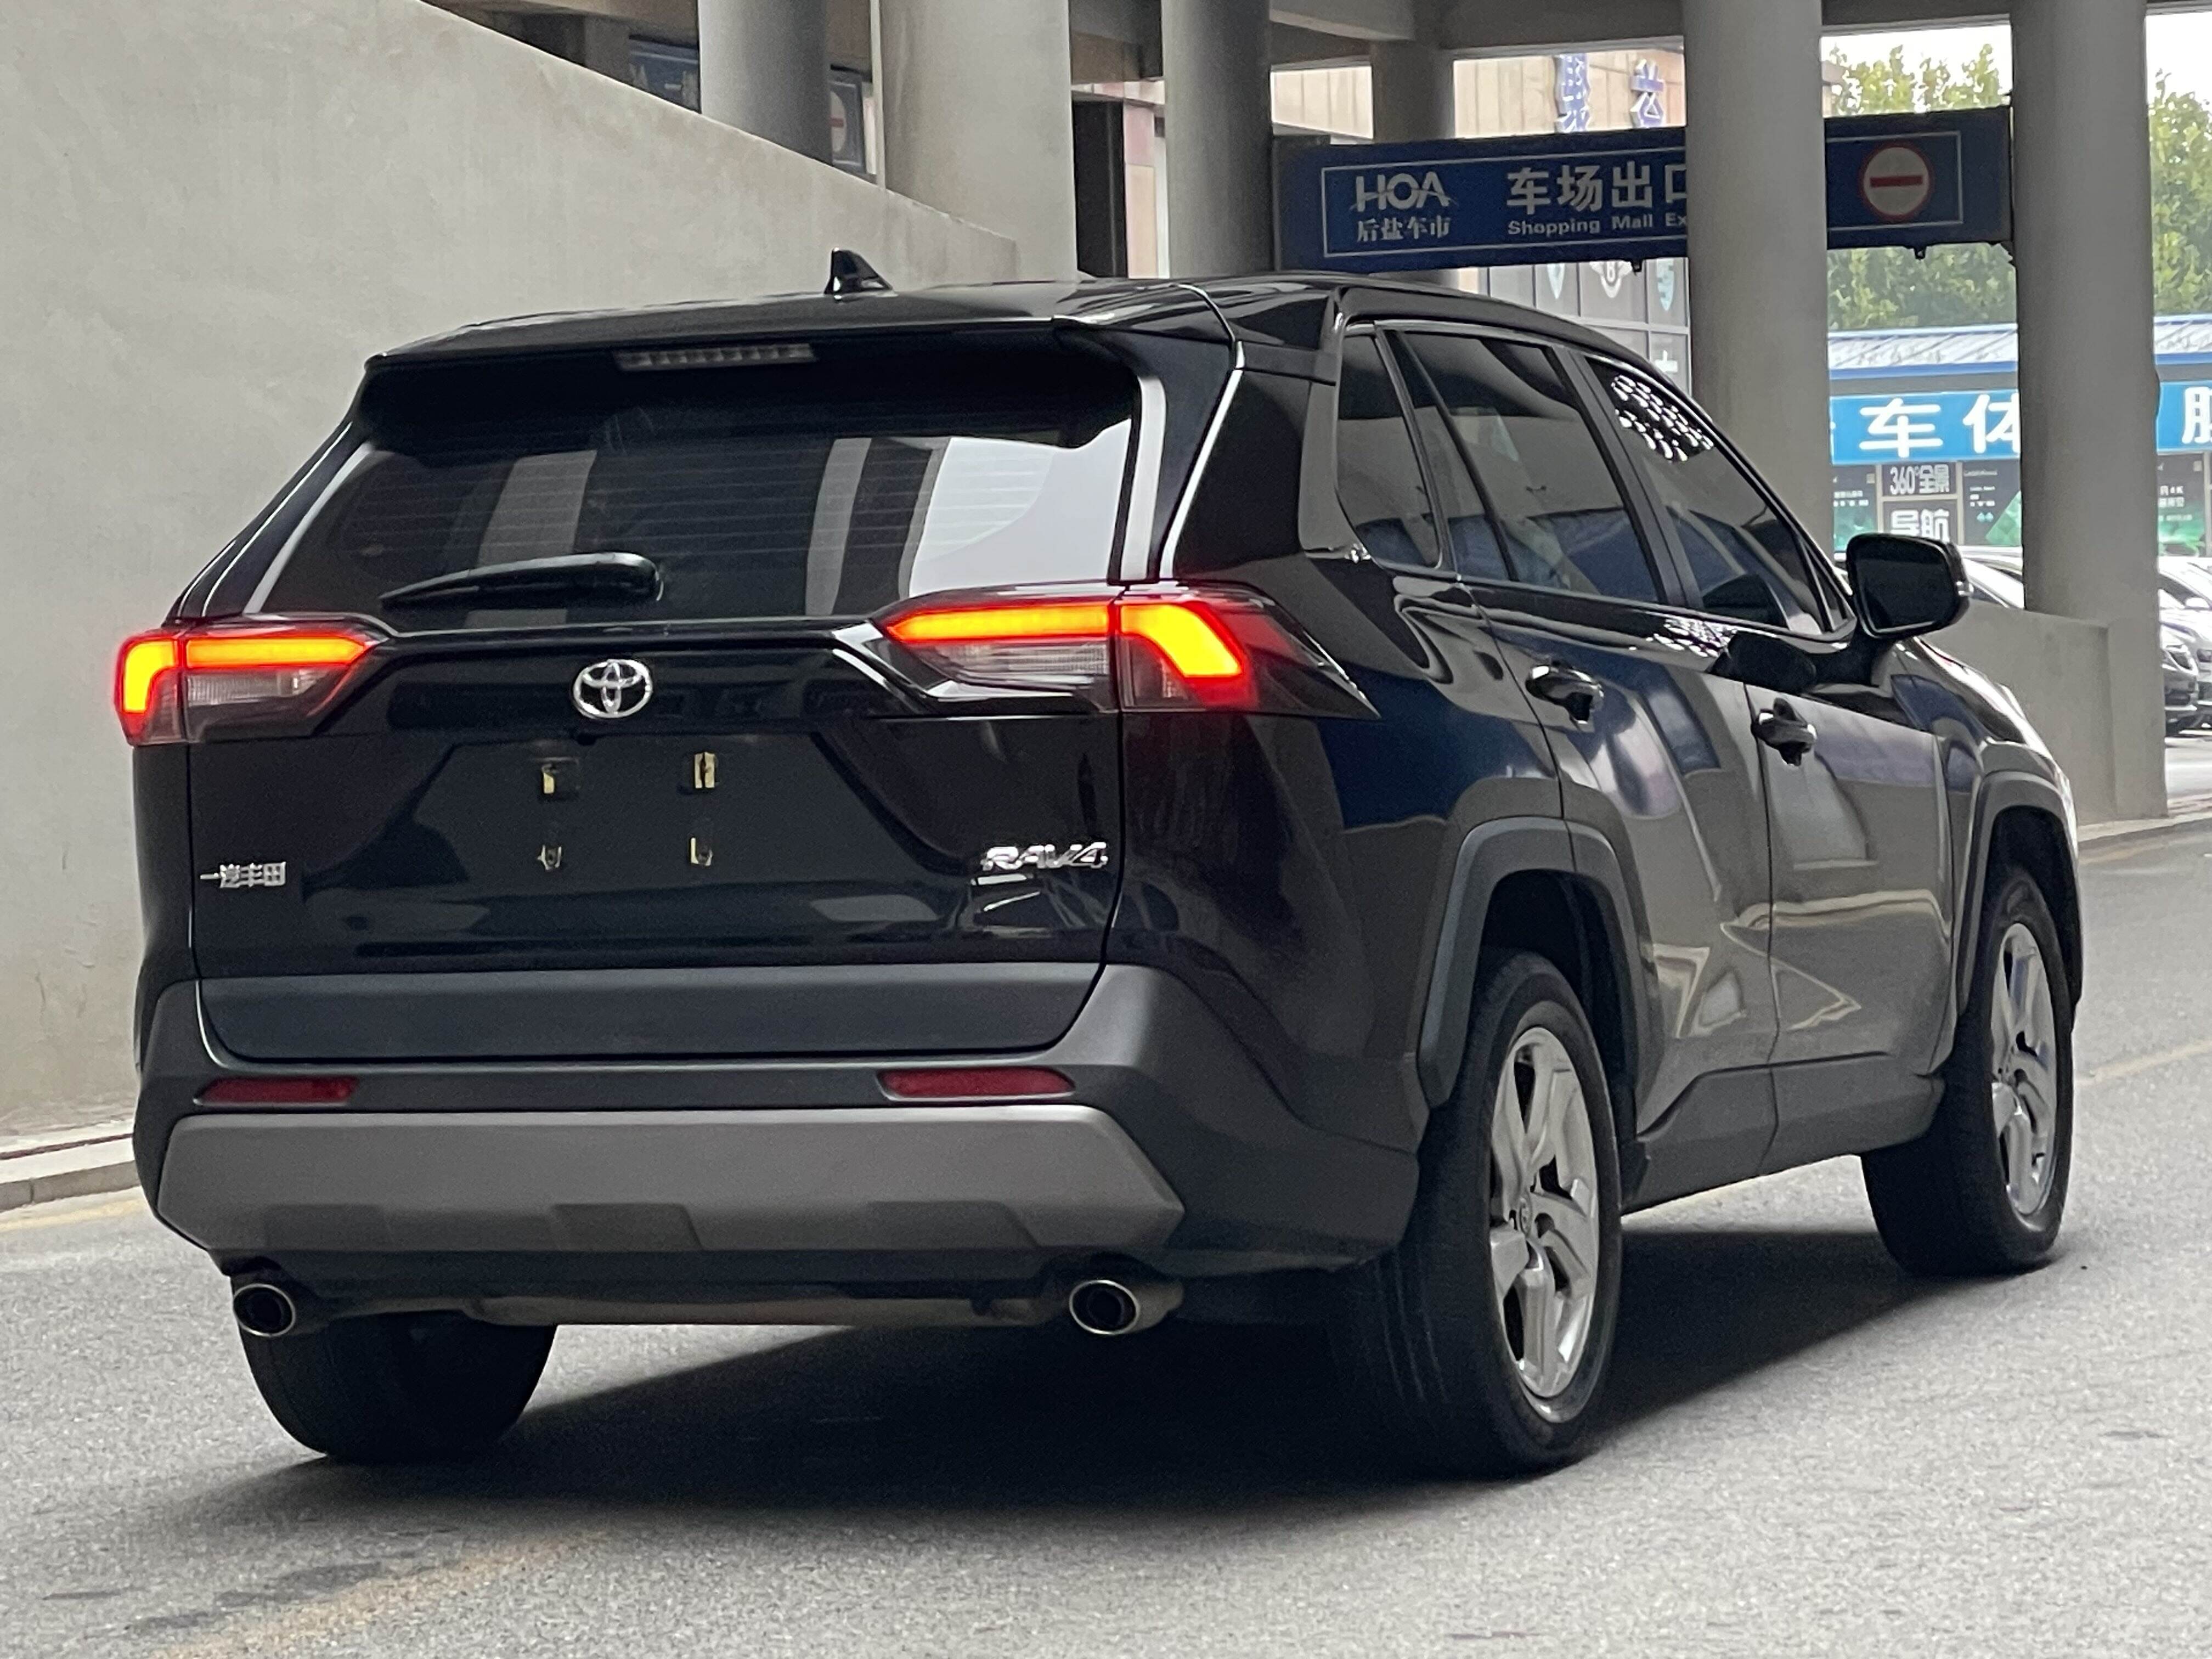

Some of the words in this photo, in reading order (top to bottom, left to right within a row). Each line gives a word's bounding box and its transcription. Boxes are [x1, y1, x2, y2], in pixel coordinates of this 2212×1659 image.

[1350, 171, 1457, 212] HOA
[1506, 161, 1686, 215] 车场出口
[1508, 219, 1600, 237] Shopping
[1611, 213, 1653, 230] Mall
[980, 842, 1108, 871] RAV4
